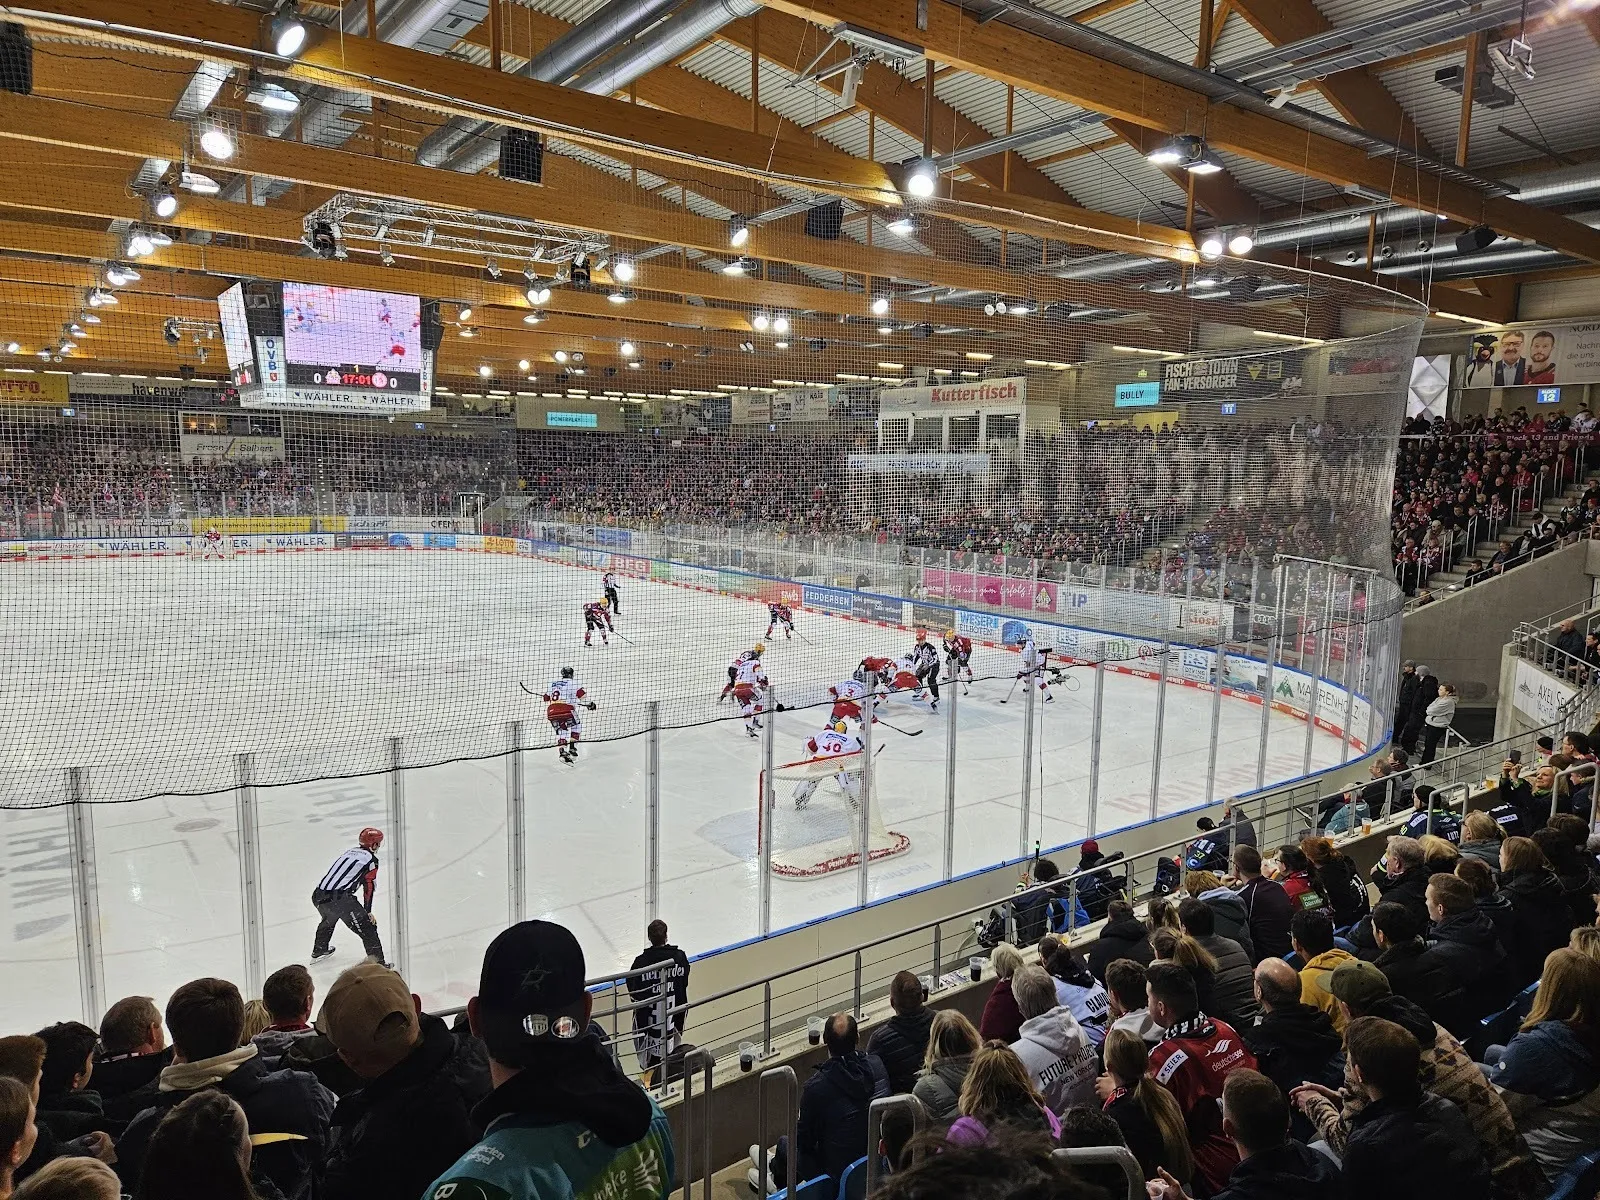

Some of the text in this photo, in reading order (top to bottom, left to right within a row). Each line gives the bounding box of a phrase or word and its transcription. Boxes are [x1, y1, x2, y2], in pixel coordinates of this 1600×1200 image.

[1165, 359, 1238, 378] FISCH TOWN
[313, 372, 398, 388] 0 17:01 0
[1164, 375, 1237, 392] FAN-VERSORGER
[303, 391, 417, 406] WÄHLER. WÄHLER.
[931, 381, 1017, 403] Kutterfisch
[1120, 390, 1145, 400] BULLY
[1542, 394, 1556, 403] 12
[1543, 433, 1559, 441] and
[1561, 433, 1595, 442] Friends
[108, 541, 170, 551] WÄHLER.
[275, 534, 328, 548] WÄHLER.
[494, 538, 515, 549] LOTTO
[804, 591, 850, 606] FEDDERSEN
[959, 612, 994, 628] WESER
[1297, 683, 1359, 720] MARENHOZ
[1537, 684, 1555, 706] AXEL
[1038, 1054, 1074, 1087] FUTURE
[1164, 1053, 1185, 1075] SEIER.
[1060, 1073, 1075, 1086] NEW
